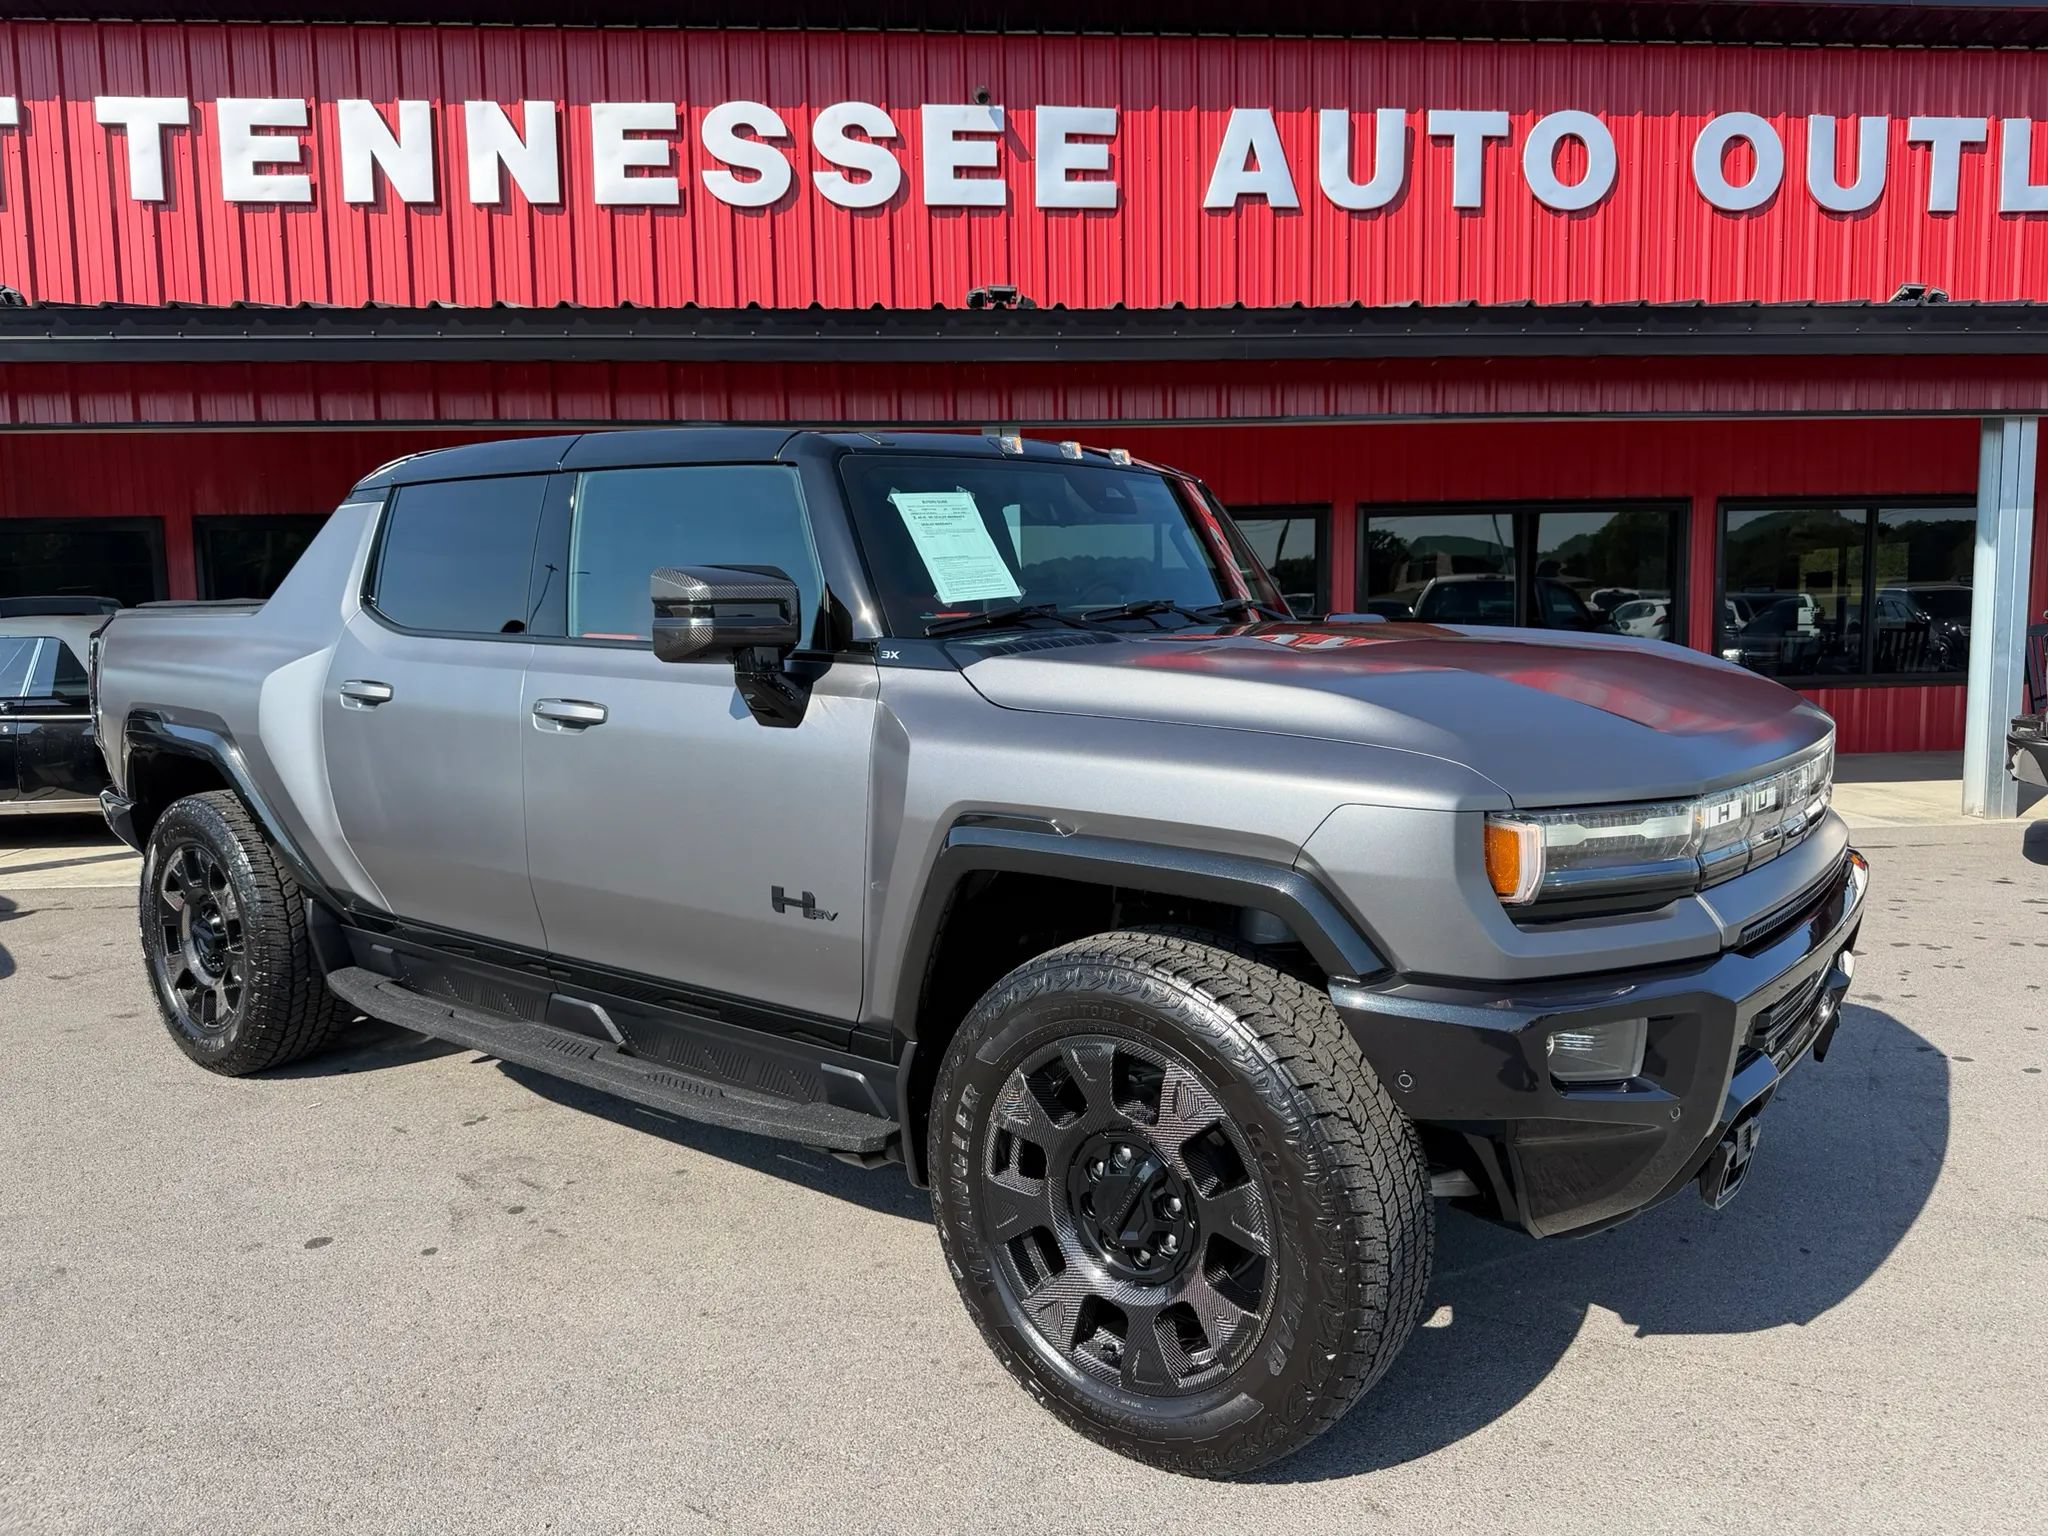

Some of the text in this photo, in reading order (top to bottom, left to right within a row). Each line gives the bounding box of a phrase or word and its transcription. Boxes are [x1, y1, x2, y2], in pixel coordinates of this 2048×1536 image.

[95, 96, 2048, 212] TENNESSEE AUTO OUTL
[881, 650, 900, 660] 3X
